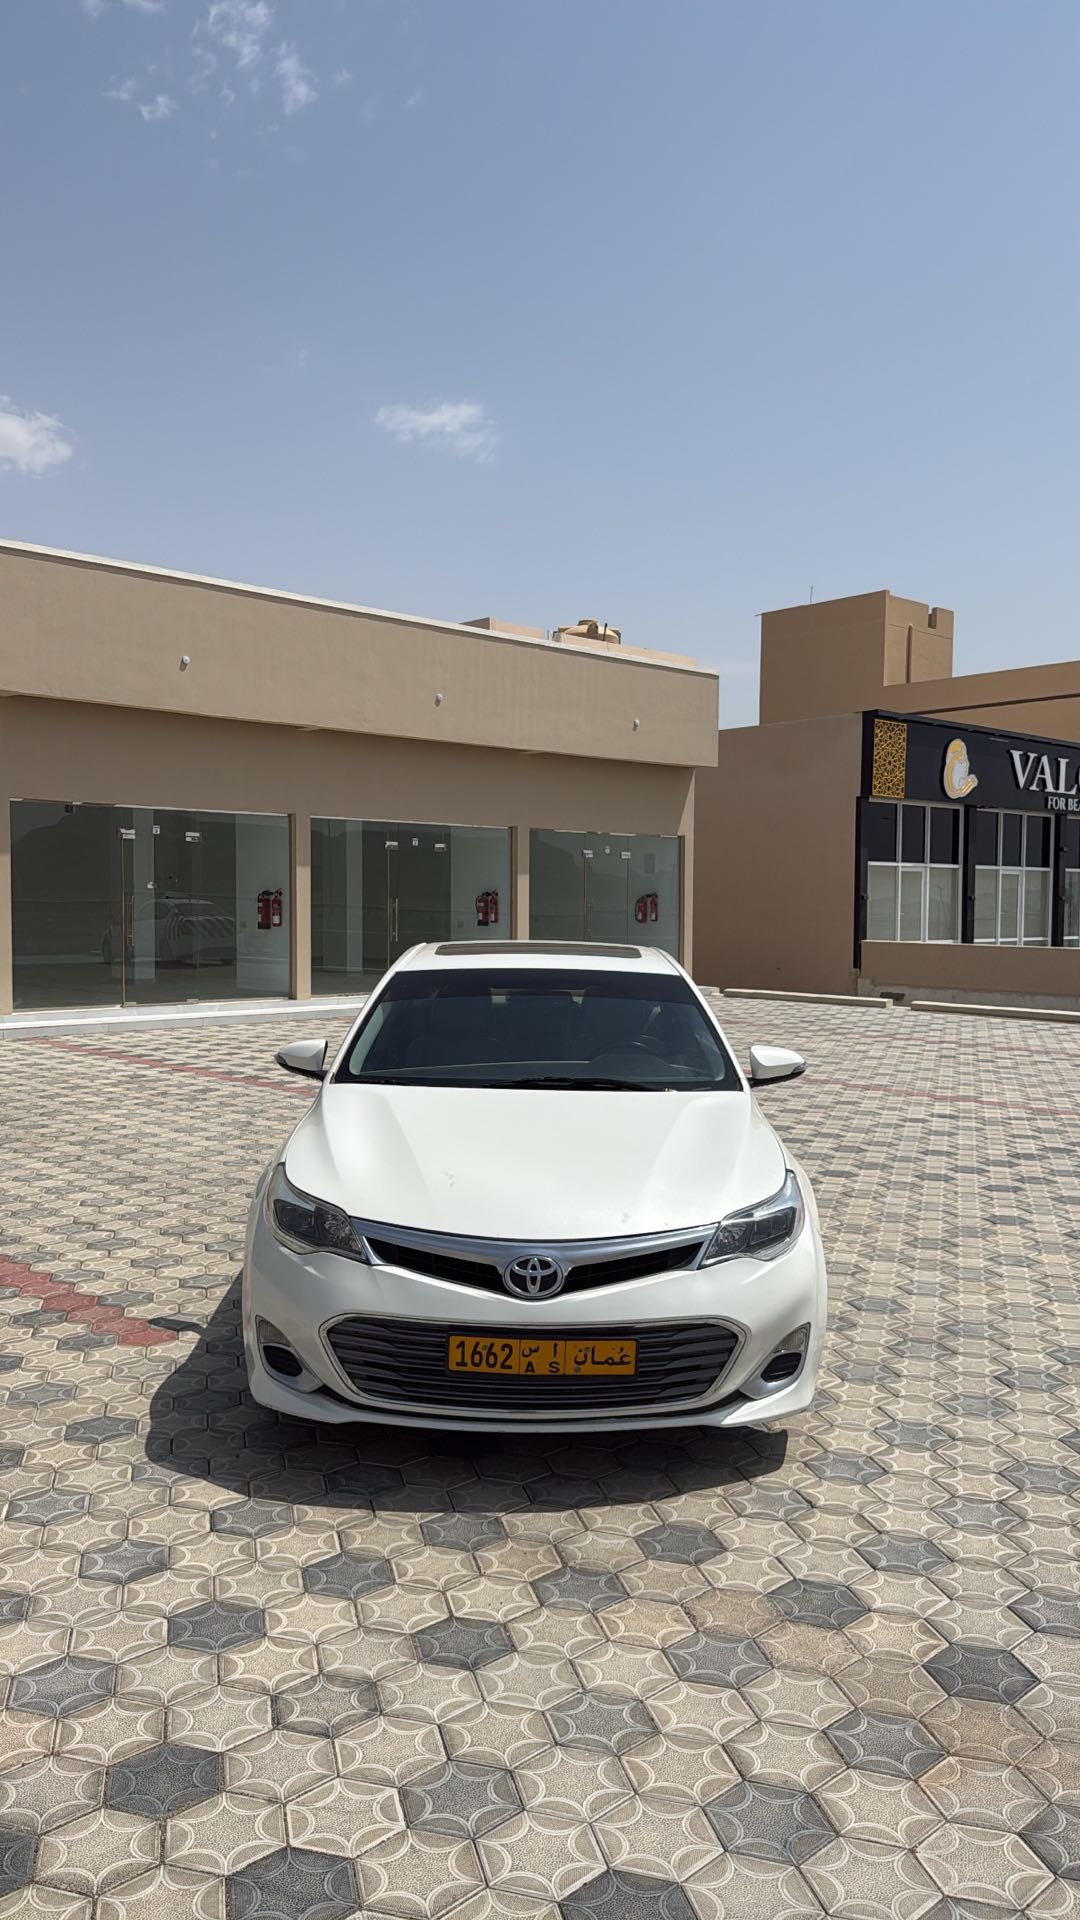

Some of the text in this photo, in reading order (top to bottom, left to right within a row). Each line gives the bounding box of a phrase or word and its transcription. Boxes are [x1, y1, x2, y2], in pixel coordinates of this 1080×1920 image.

[1009, 749, 1080, 795] VAL
[1047, 796, 1080, 812] FOR BE
[455, 1340, 513, 1370] 1662
[521, 1345, 540, 1358] س
[524, 1361, 560, 1374] A S
